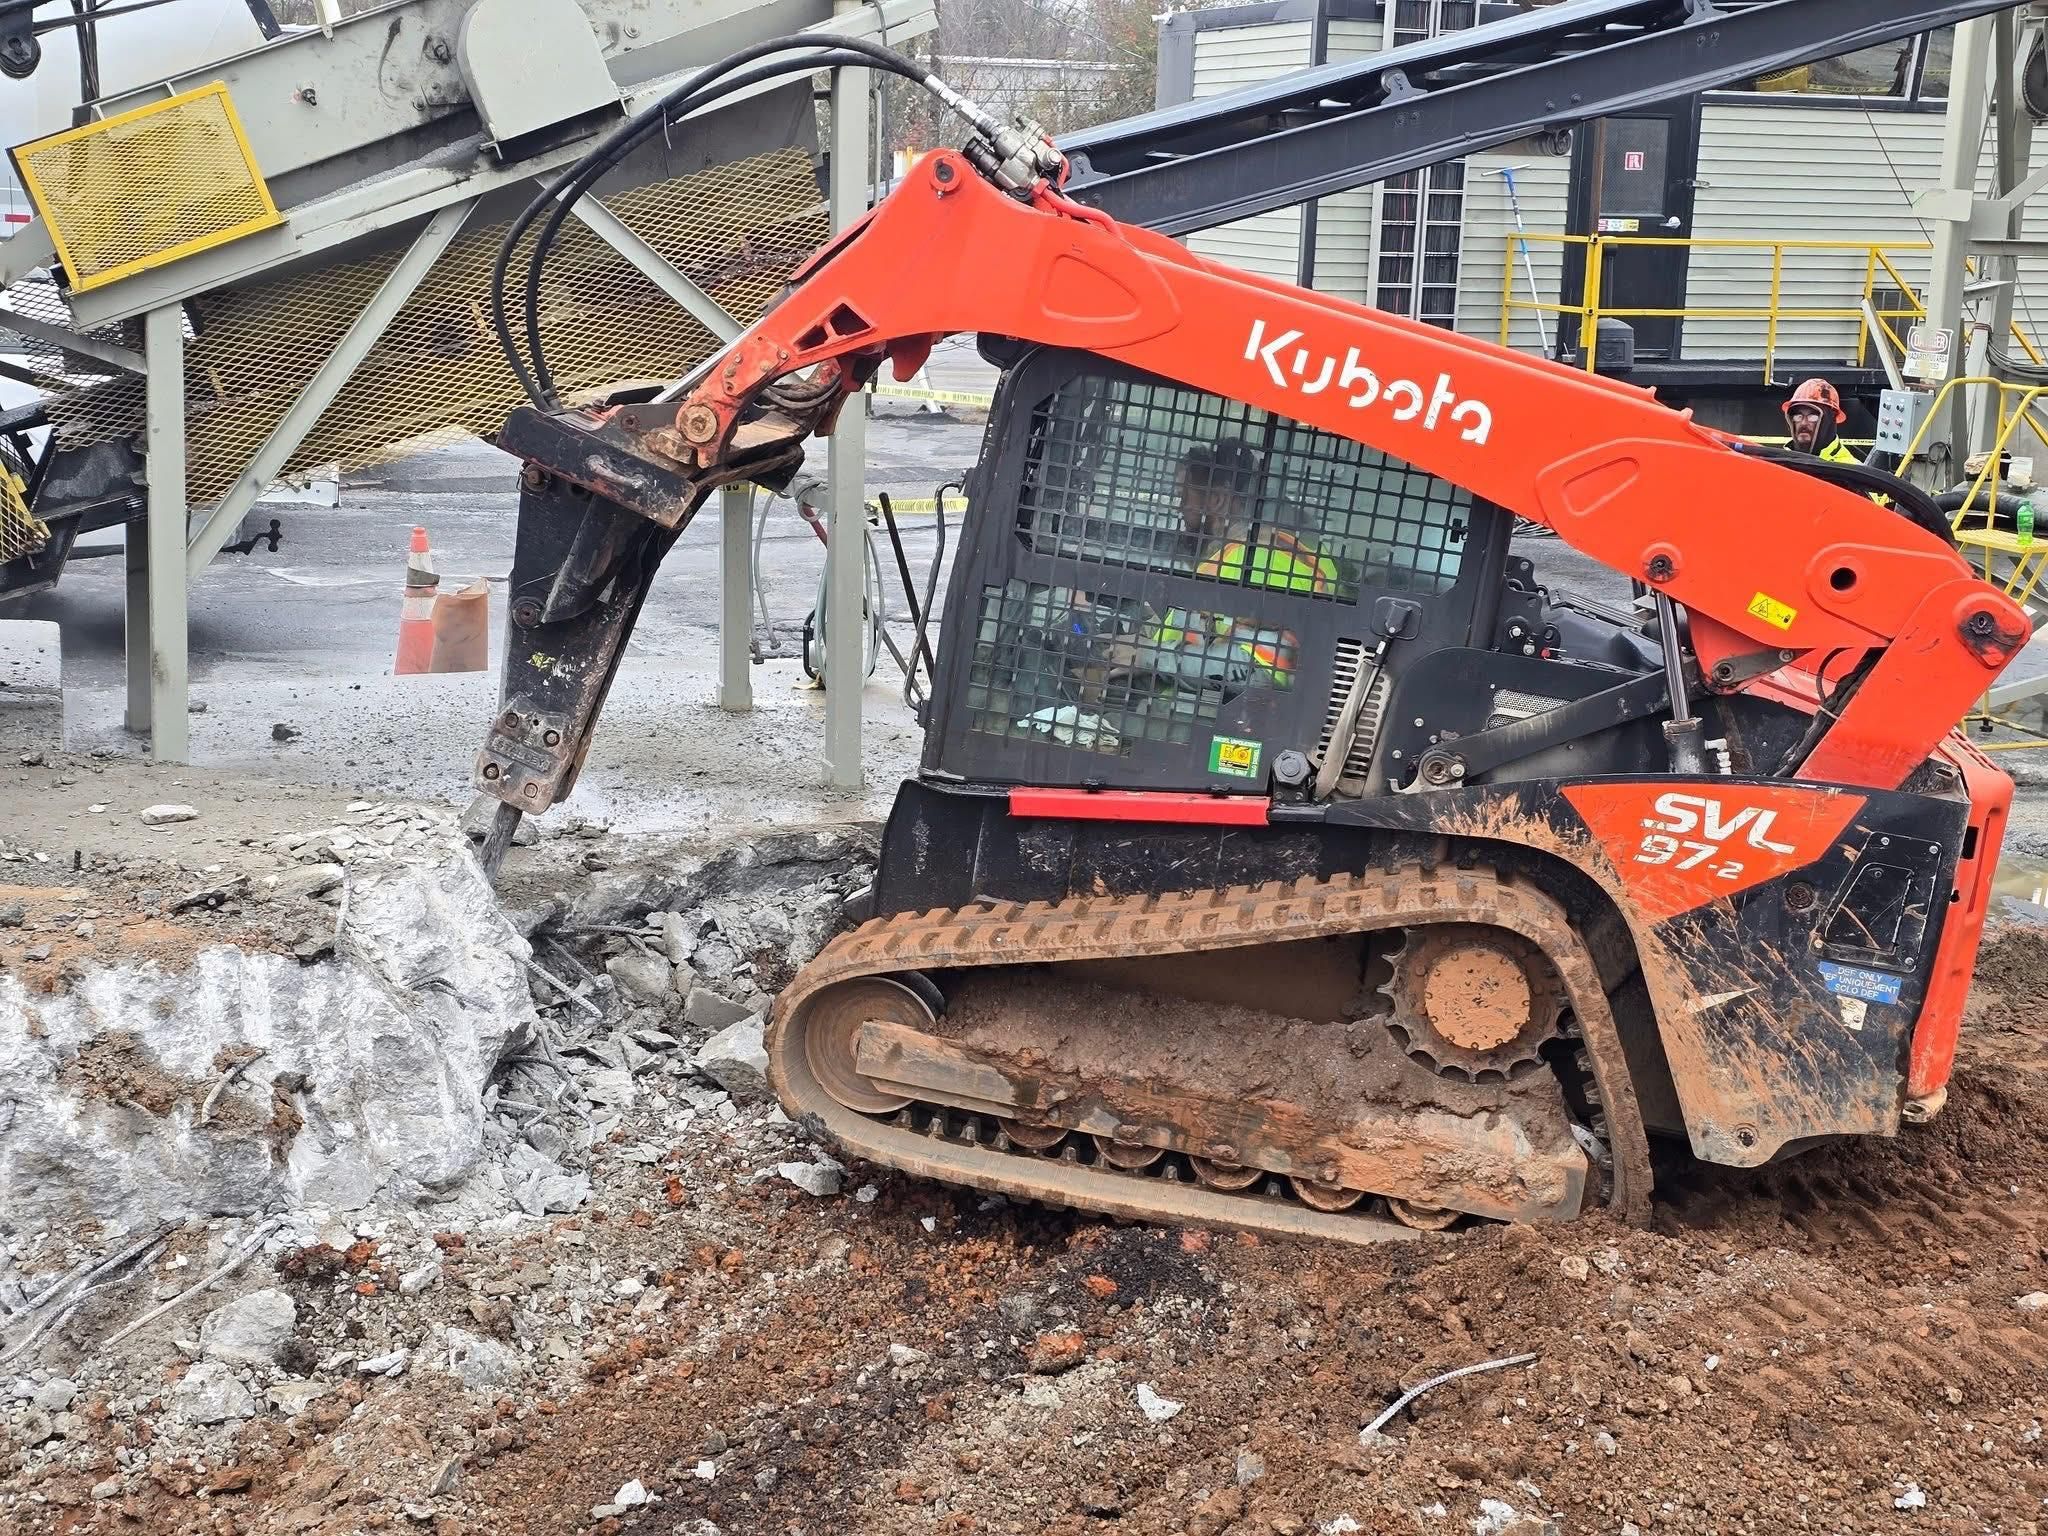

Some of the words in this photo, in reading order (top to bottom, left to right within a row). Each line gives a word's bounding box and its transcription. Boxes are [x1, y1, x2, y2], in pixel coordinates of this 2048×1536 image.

[1244, 319, 1492, 445] Kubota
[1641, 792, 1796, 854] SVL
[1838, 967, 1857, 977] DEF
[1859, 971, 1883, 983] ONLY
[1834, 984, 1859, 995] SOLO
[1861, 990, 1880, 999] DEF
[1839, 976, 1897, 994] UNIQUEMENT
